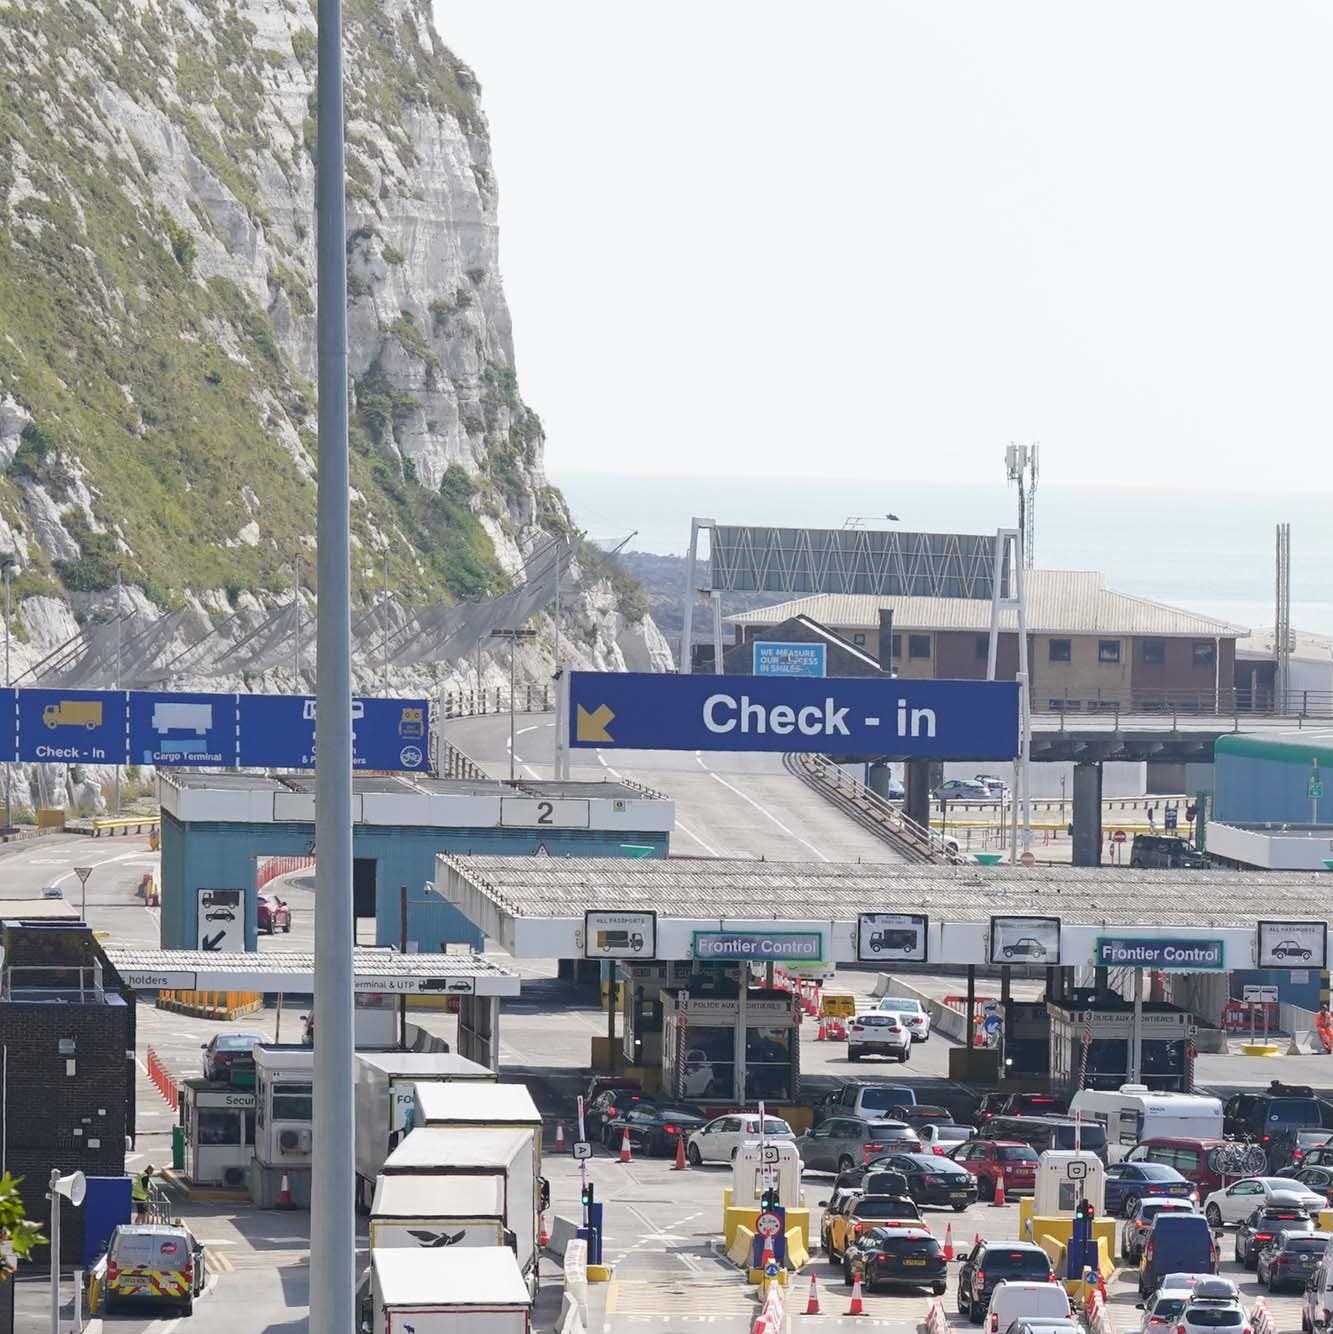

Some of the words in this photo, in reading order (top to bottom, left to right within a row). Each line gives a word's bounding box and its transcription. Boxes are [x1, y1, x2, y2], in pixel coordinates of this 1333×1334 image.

[703, 694, 850, 736] Check
[897, 700, 937, 737] in
[36, 745, 78, 759] Check
[92, 746, 105, 759] In
[153, 751, 181, 764] Cargo
[183, 752, 222, 763] Terminal
[537, 802, 554, 825] 2
[700, 939, 757, 953] Frontier
[759, 938, 817, 953] Control
[1103, 946, 1160, 960] Frontier
[1163, 946, 1219, 961] Control
[129, 973, 168, 985] holders
[354, 980, 386, 989] erminal
[397, 980, 415, 989] UTP
[693, 1002, 719, 1010] POLICE
[1094, 1014, 1114, 1022] OLICE
[226, 1095, 255, 1106] Secur
